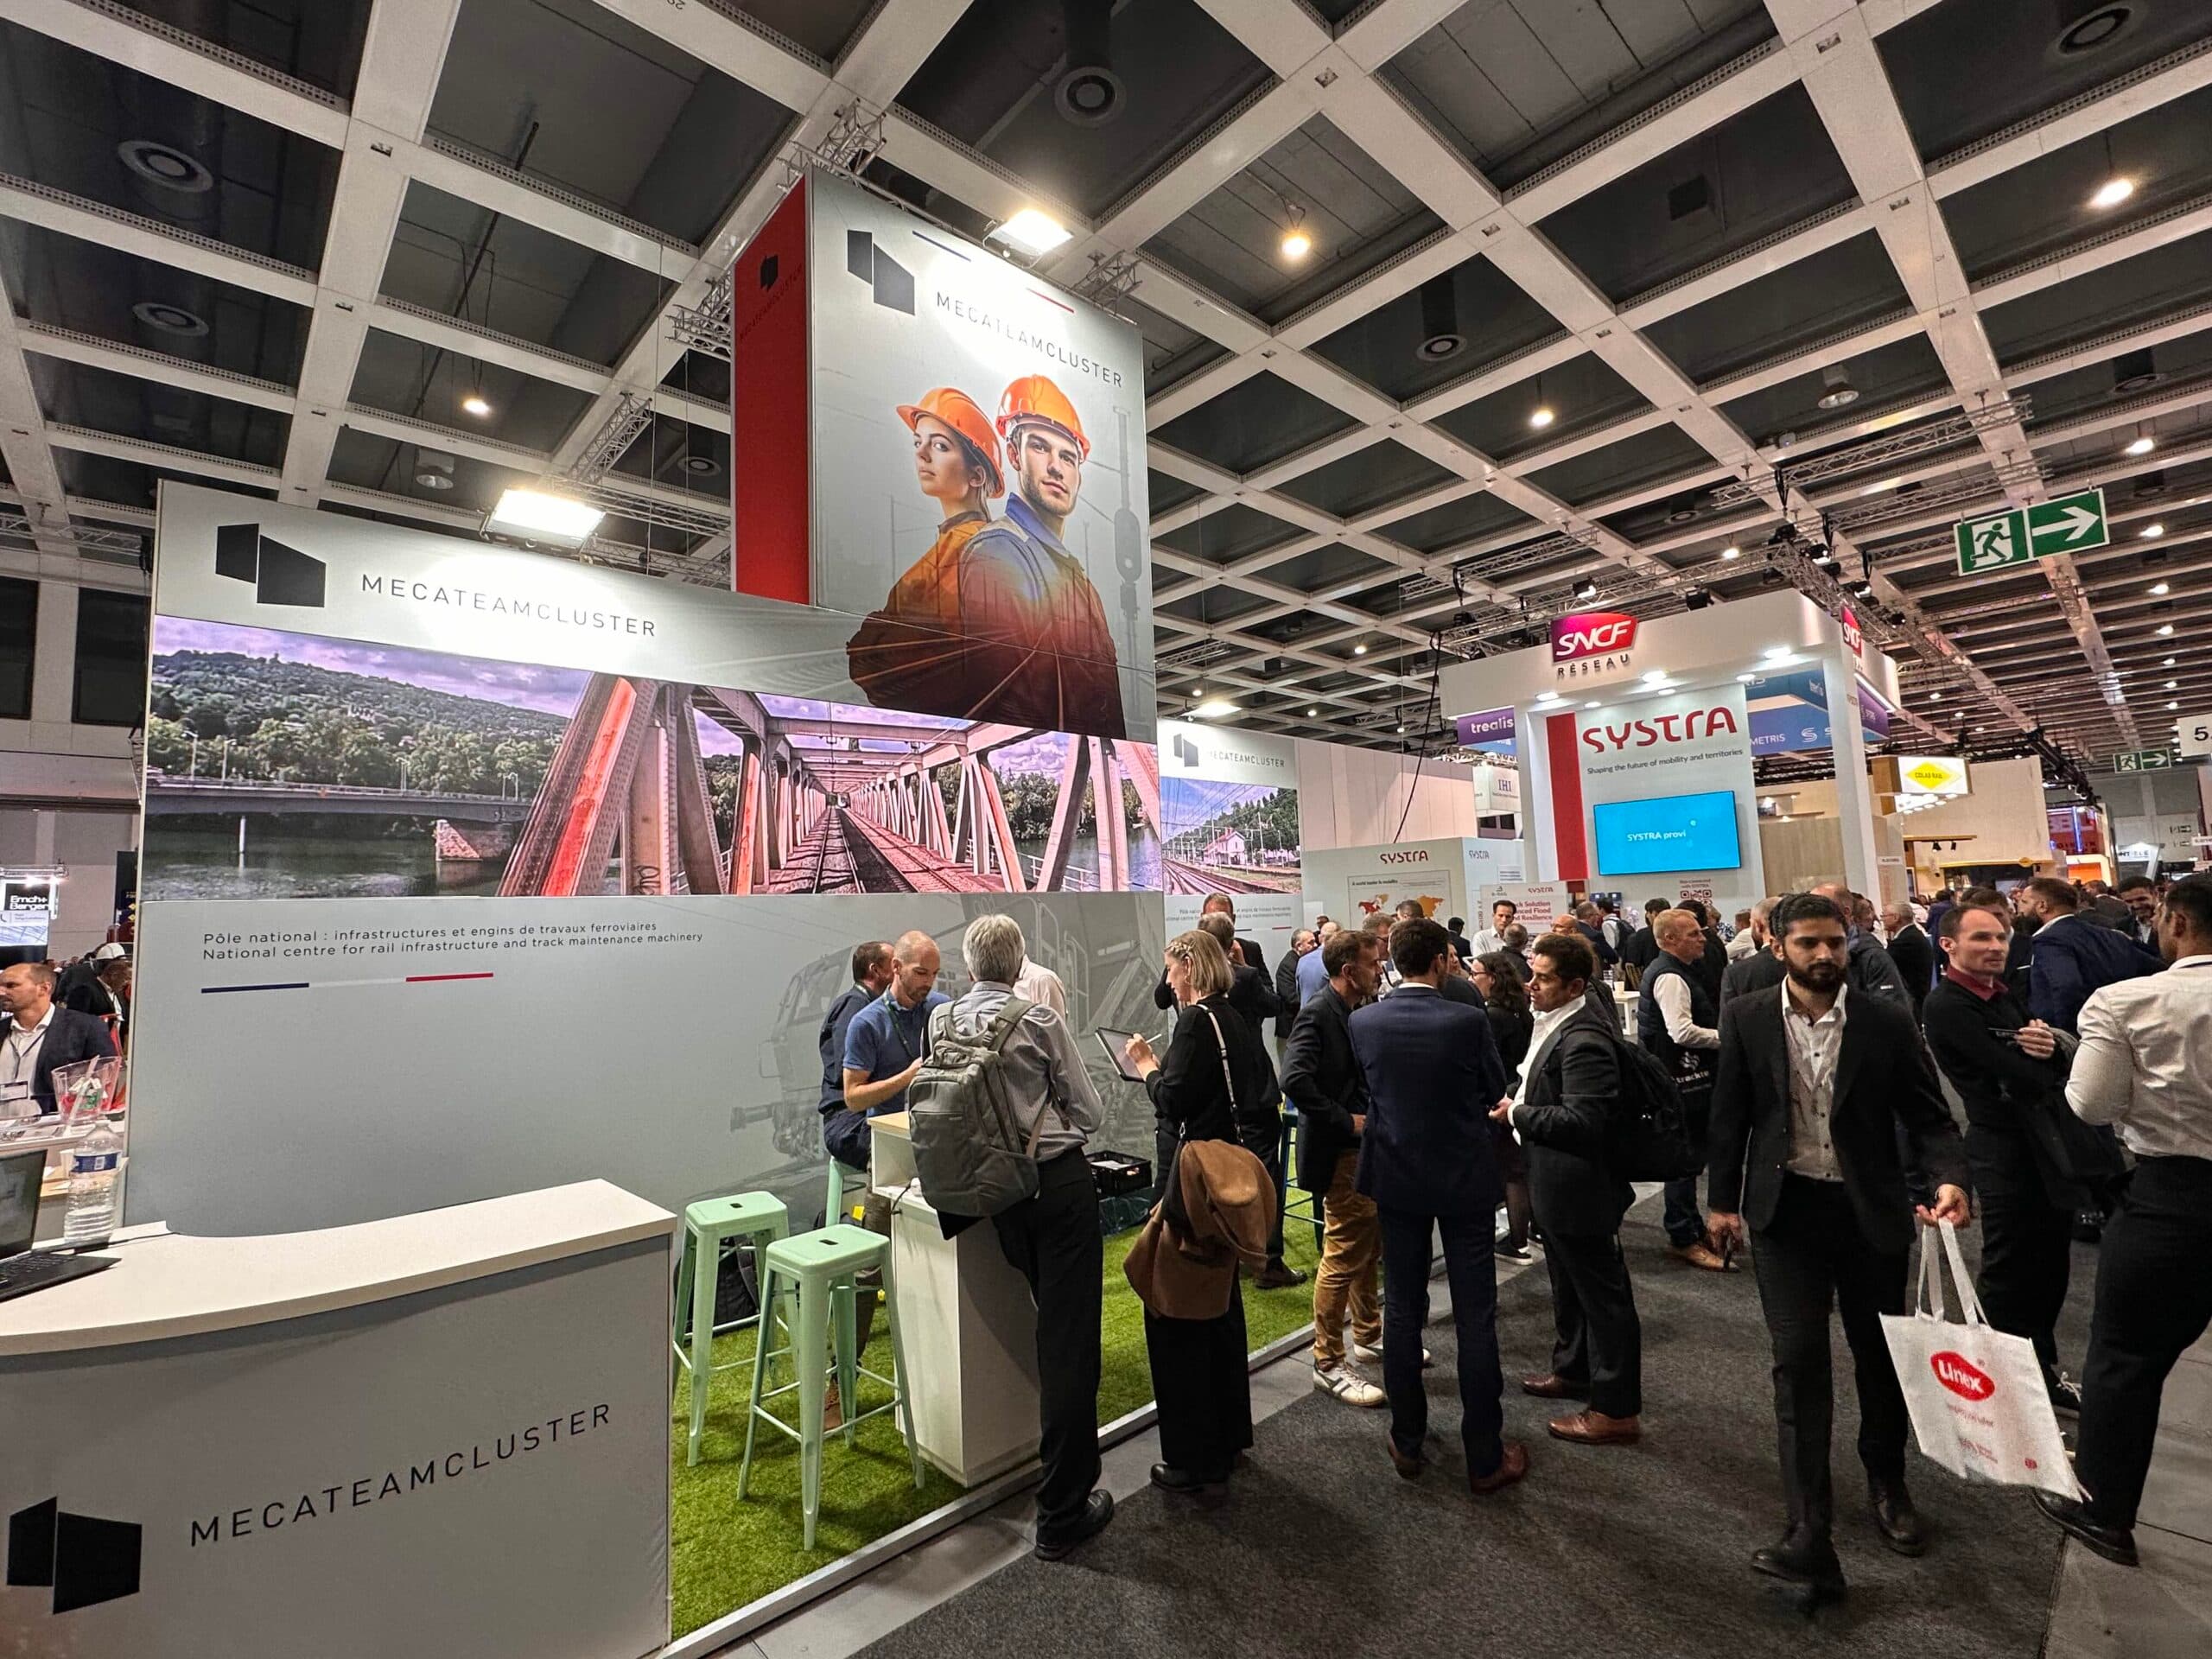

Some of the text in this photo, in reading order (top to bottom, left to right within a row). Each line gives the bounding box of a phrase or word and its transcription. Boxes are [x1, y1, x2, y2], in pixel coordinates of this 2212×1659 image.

[362, 574, 656, 637] MECATEAMCLUSTER
[1555, 620, 1632, 656] SNCF
[1557, 653, 1630, 677] RÉSEAU
[1582, 707, 1738, 753] SYSTRA
[2194, 726, 2212, 741] 5
[1659, 755, 1688, 765] mobility
[1706, 749, 1743, 760] territories
[1627, 831, 1662, 842] SYSTRA
[1380, 850, 1429, 864] SYSTRA
[203, 932, 702, 960] National centre for rail infrastructure and track maintenance machinery
[204, 932, 241, 944] Pôle
[249, 931, 317, 944] national
[334, 928, 446, 940] infrastructures
[452, 927, 465, 938] et
[471, 925, 514, 938] engins
[519, 925, 535, 935] de
[540, 925, 586, 935] travaux
[591, 922, 657, 932] ferroviaires
[1938, 1358, 1985, 1394] Unex
[191, 1403, 610, 1548] MECATEAMCLUSTER
